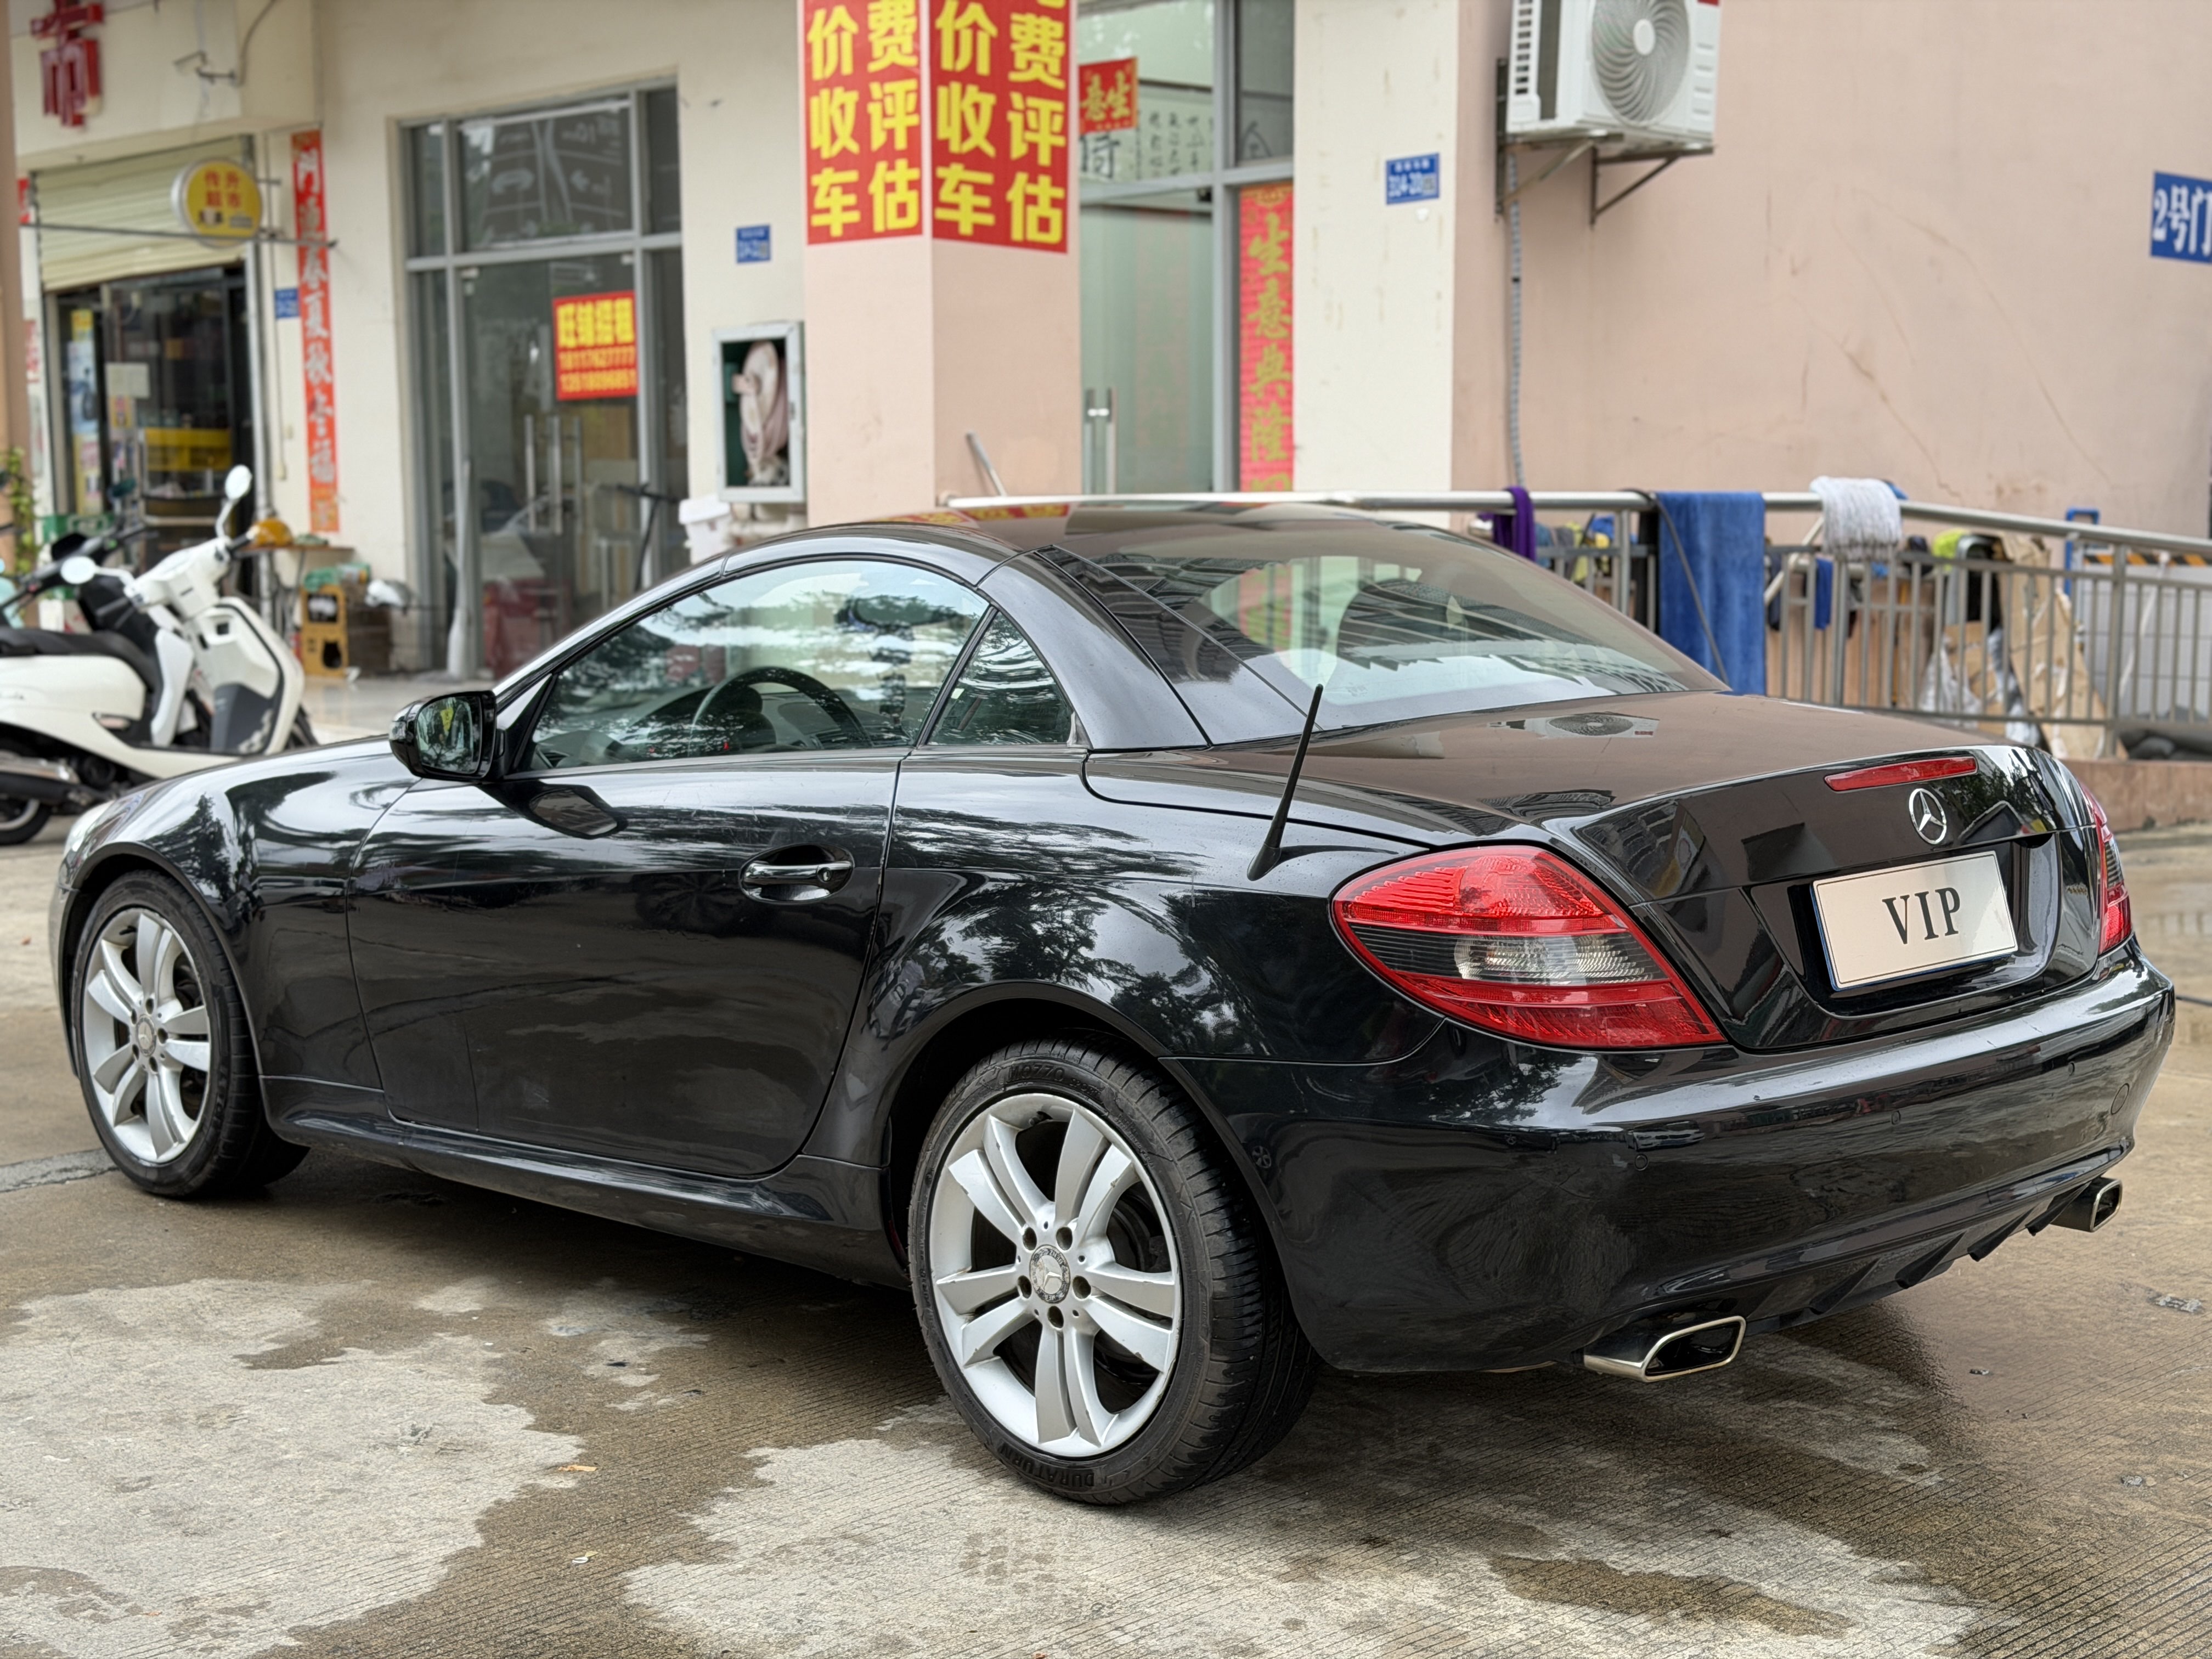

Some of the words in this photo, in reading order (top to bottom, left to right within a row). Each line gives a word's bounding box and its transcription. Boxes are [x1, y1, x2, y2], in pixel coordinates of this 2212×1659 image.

[806, 4, 861, 238] 价收车
[867, 0, 921, 233] 费评估
[935, 0, 997, 236] 价收车
[1006, 0, 1066, 245] 费评估
[1882, 887, 1960, 945] VIP
[997, 1441, 1094, 1487] DURATURN
